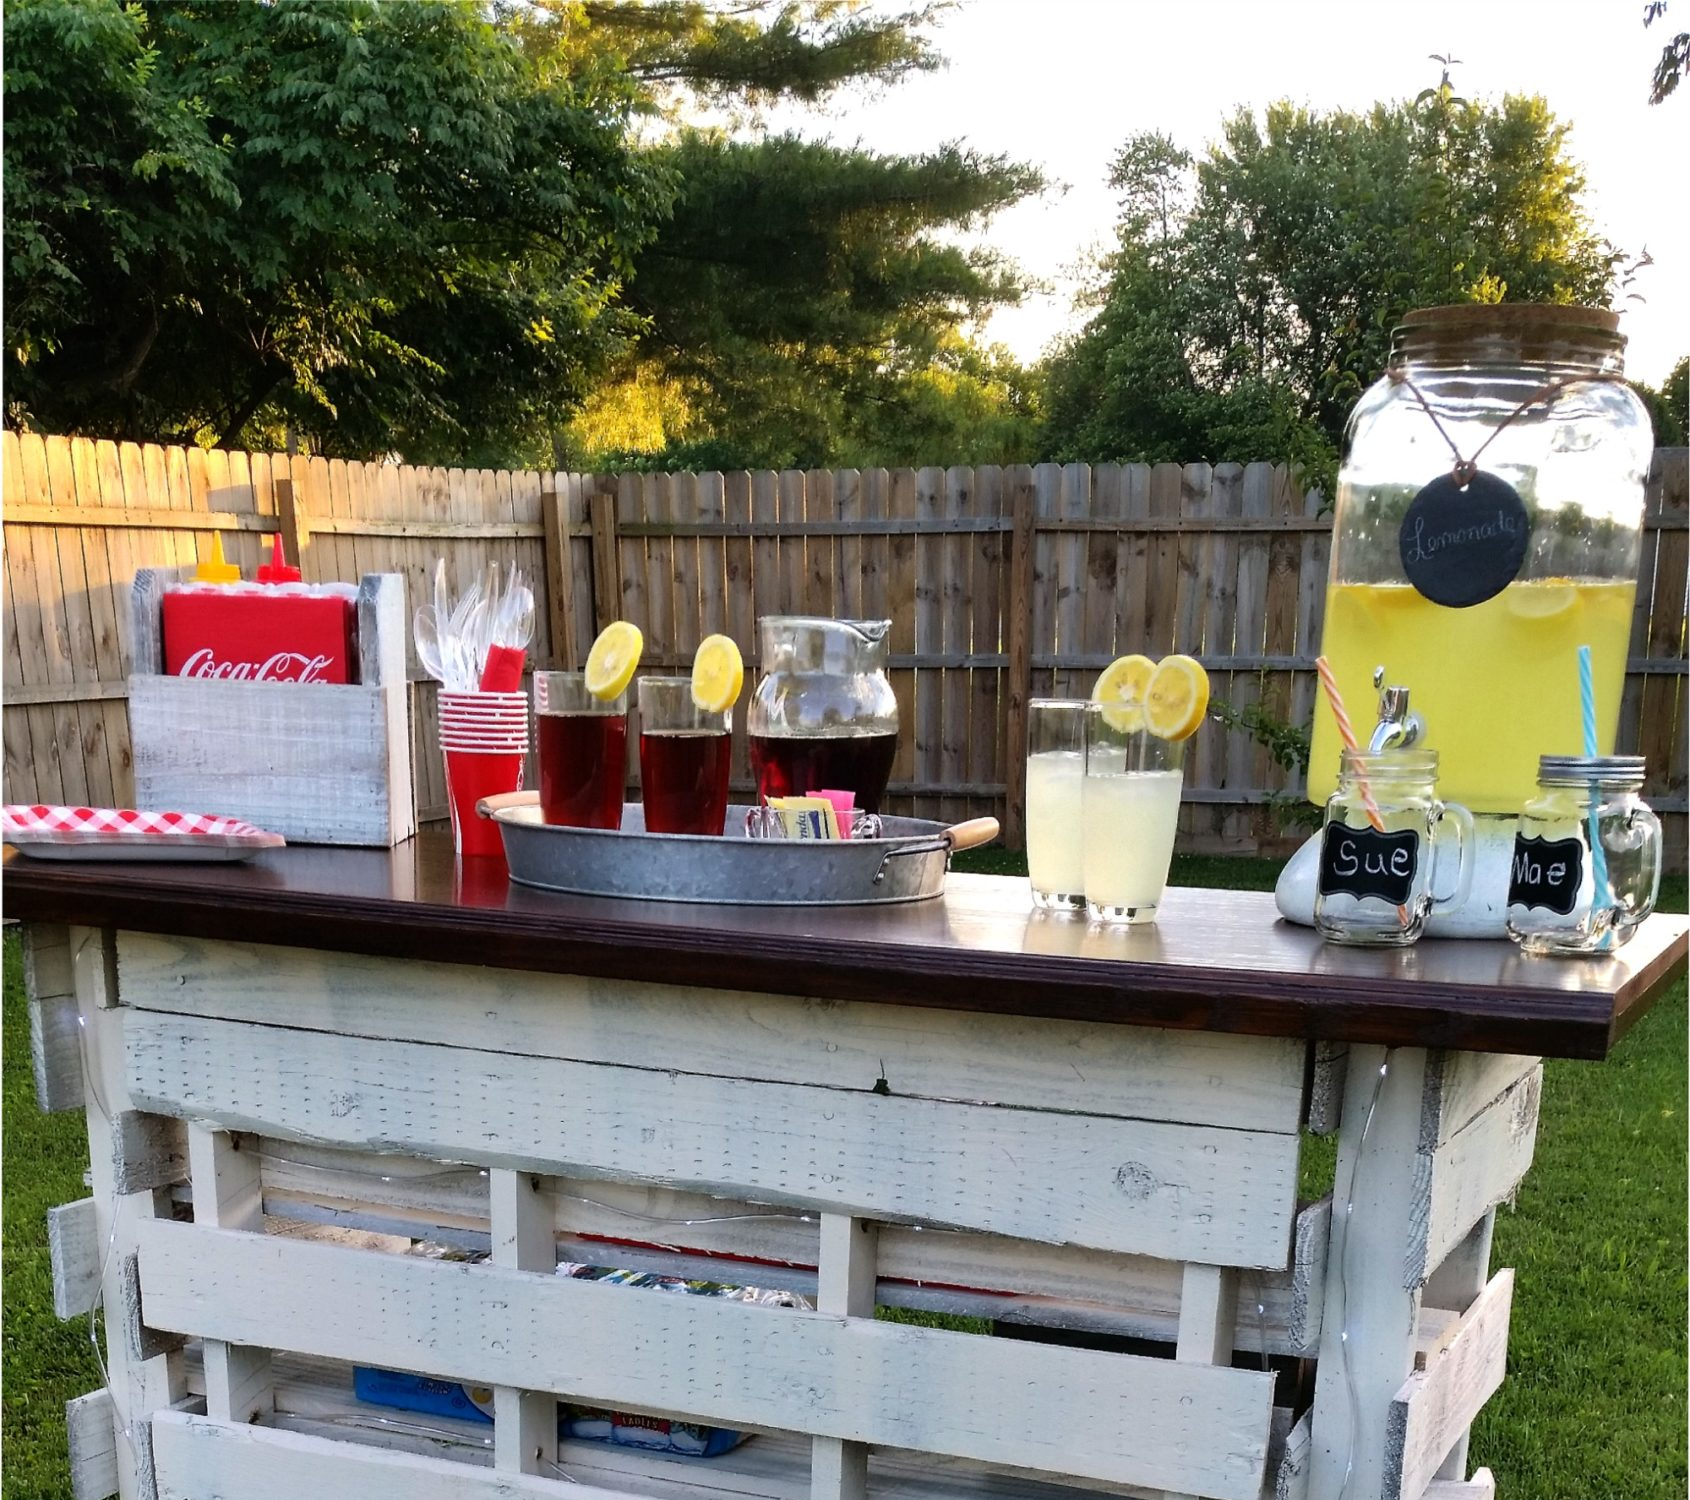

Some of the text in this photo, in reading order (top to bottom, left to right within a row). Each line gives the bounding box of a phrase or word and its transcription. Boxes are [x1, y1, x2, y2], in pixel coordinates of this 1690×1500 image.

[1406, 509, 1516, 563] Lemonade
[1333, 840, 1411, 877] Sue
[1511, 851, 1567, 886] Mae
